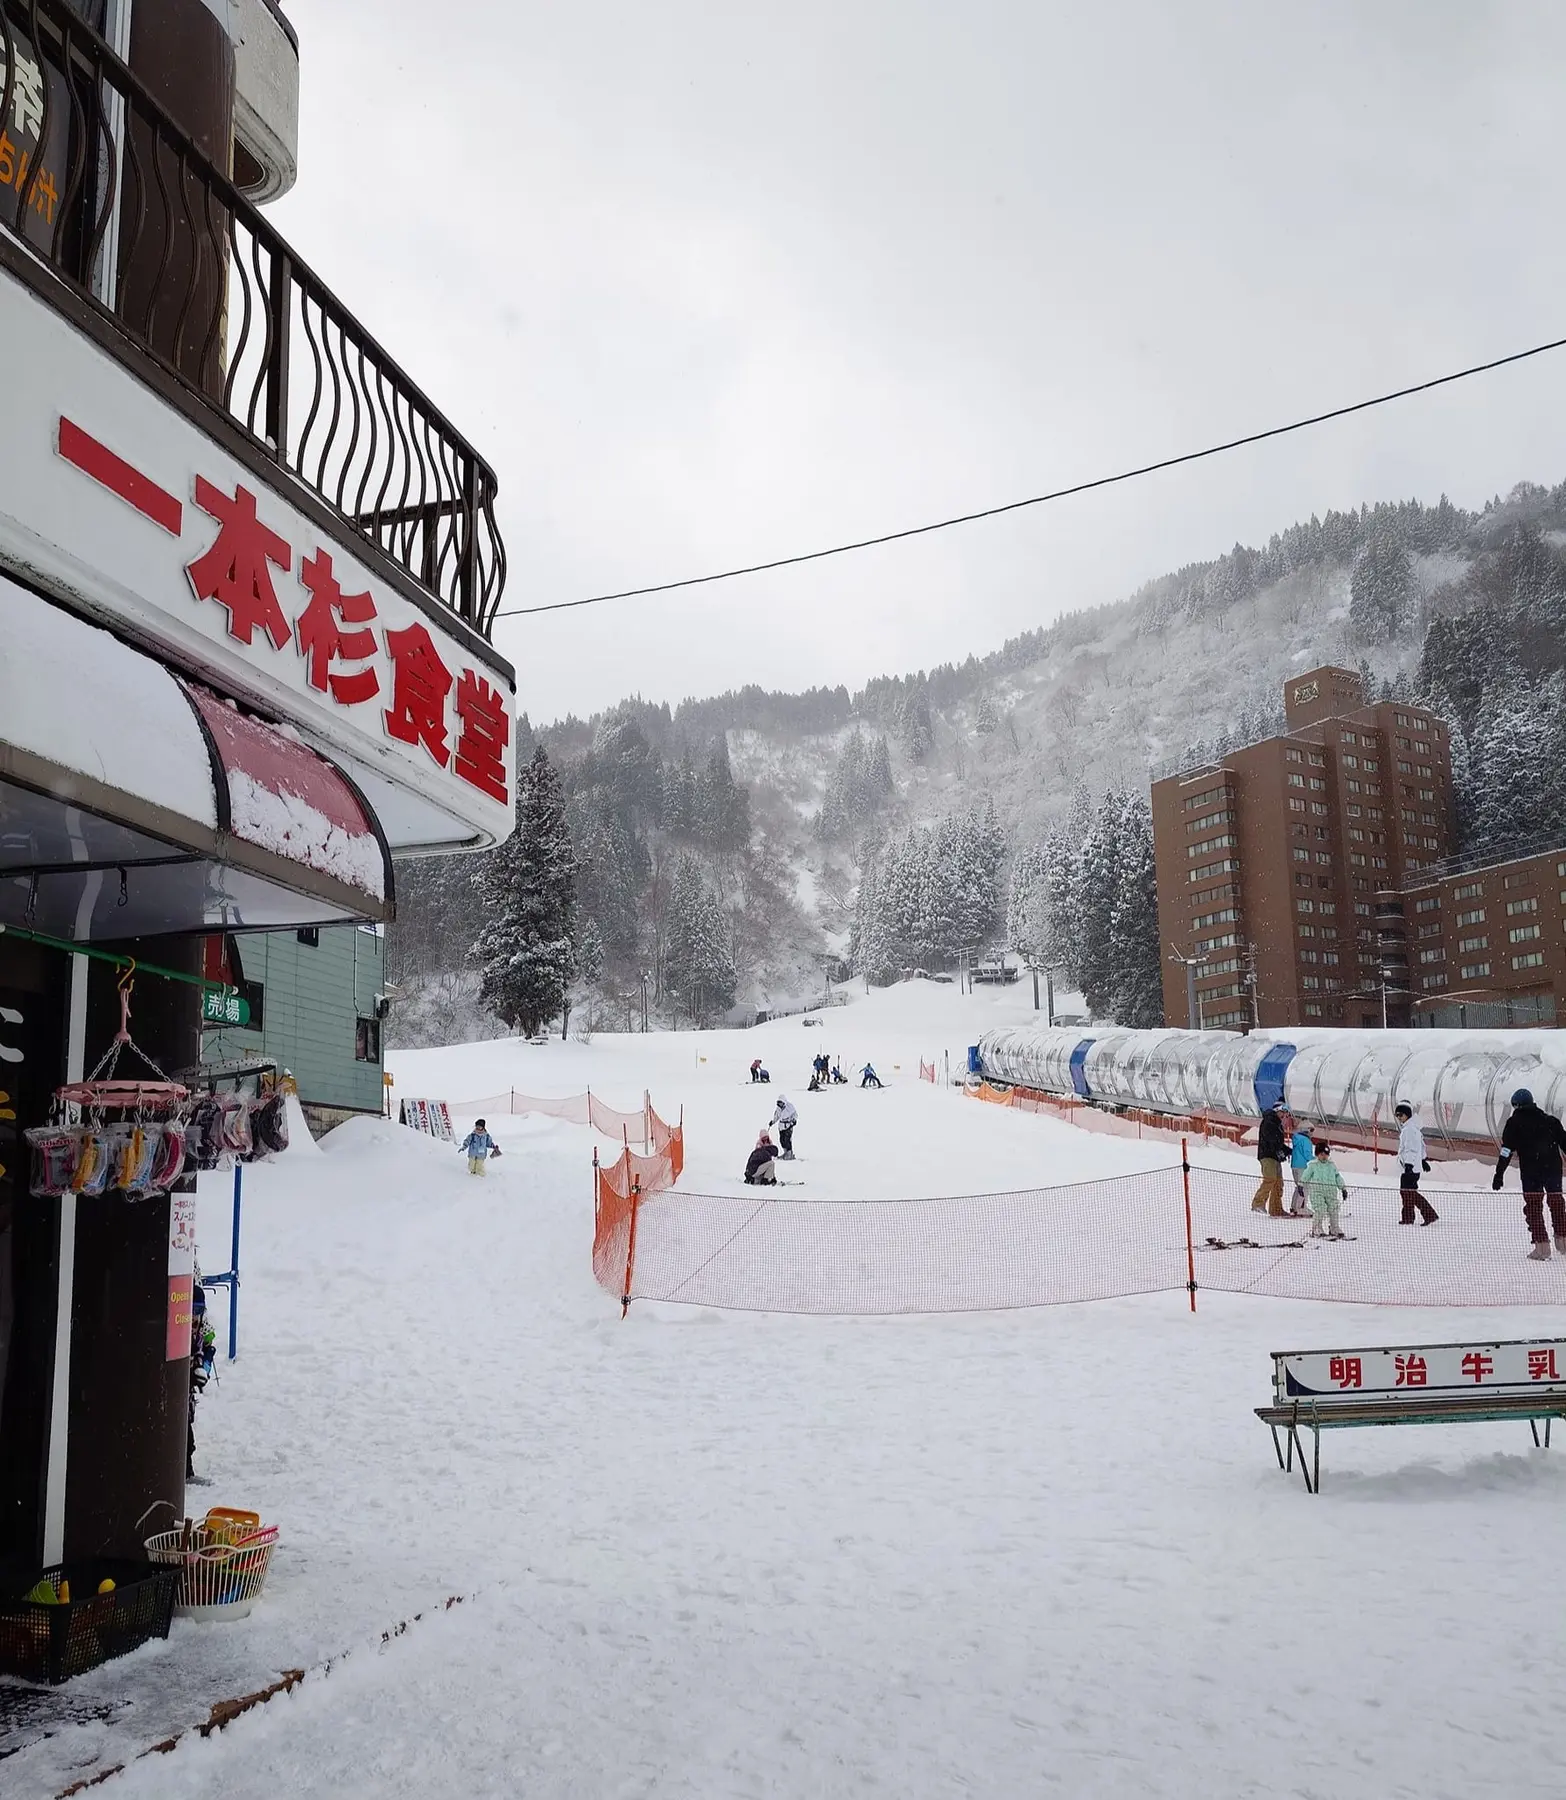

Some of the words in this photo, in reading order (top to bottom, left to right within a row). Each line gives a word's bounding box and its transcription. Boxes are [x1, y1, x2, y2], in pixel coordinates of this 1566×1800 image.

[56, 414, 510, 807] 一本杉食堂
[202, 992, 241, 1023] 売場
[1328, 1348, 1561, 1390] 明治牛乳
